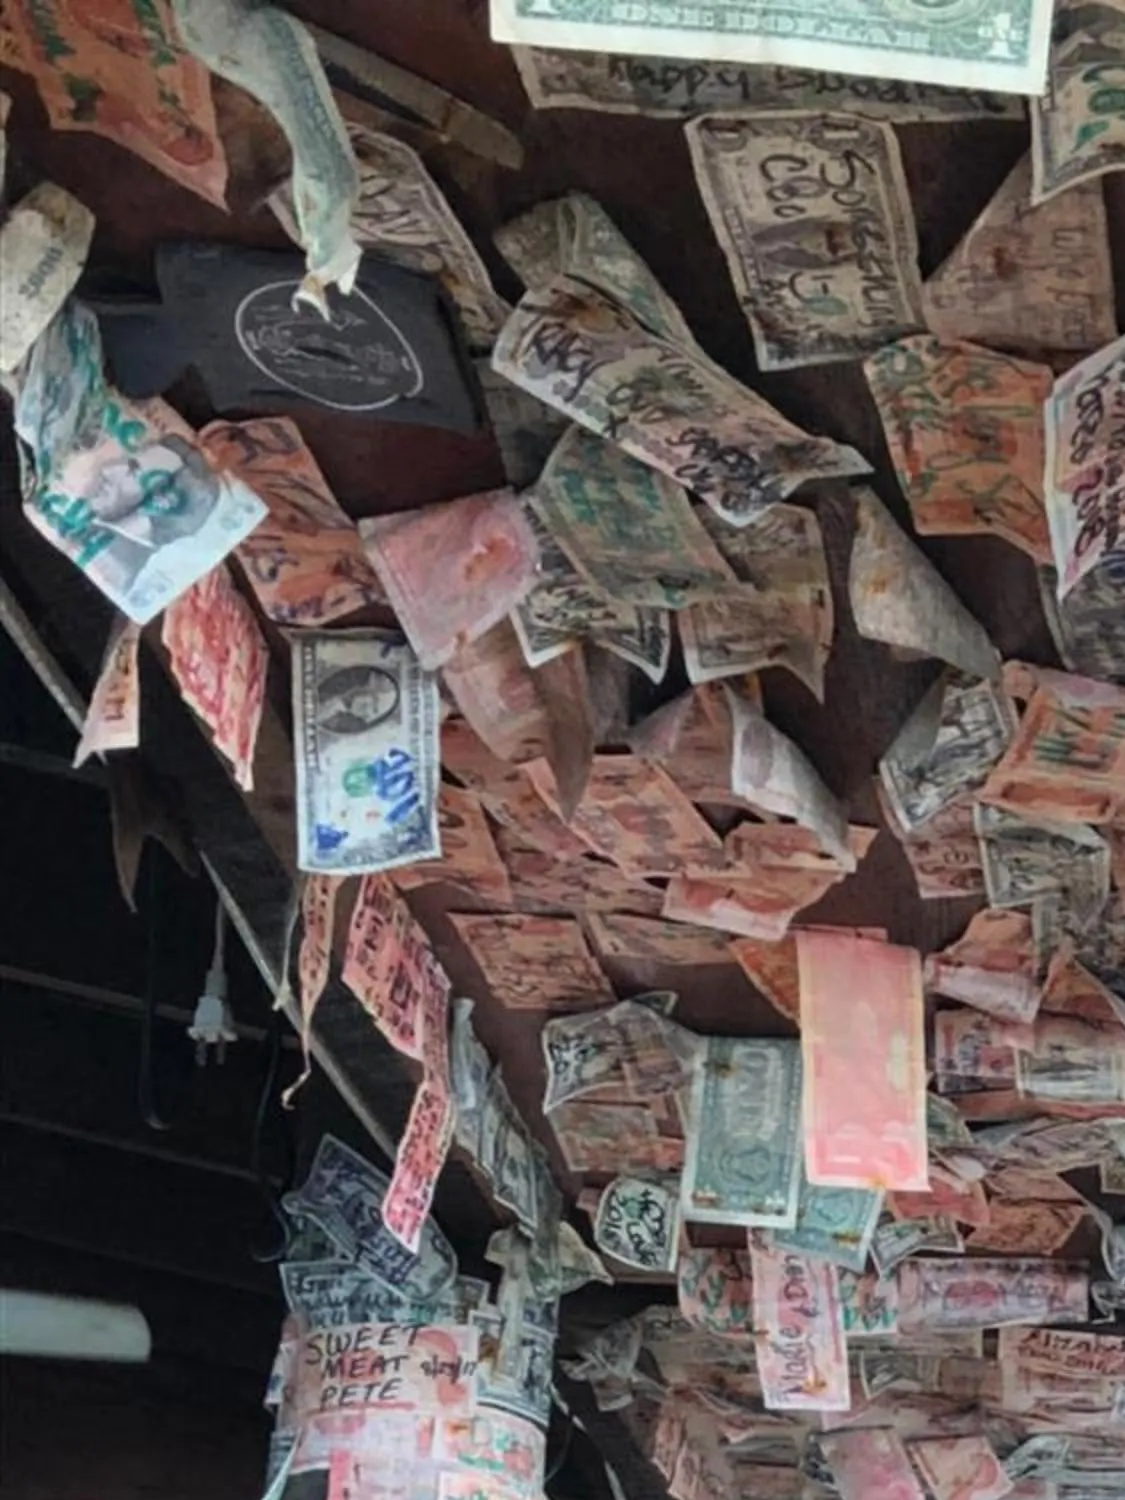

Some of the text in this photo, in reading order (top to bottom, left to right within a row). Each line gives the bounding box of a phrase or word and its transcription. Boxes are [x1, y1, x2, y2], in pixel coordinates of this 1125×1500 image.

[724, 9, 932, 49] DOLLAR
[304, 1321, 427, 1366] SWEET
[320, 1353, 410, 1381] MEAT
[319, 1378, 404, 1412] PETE
